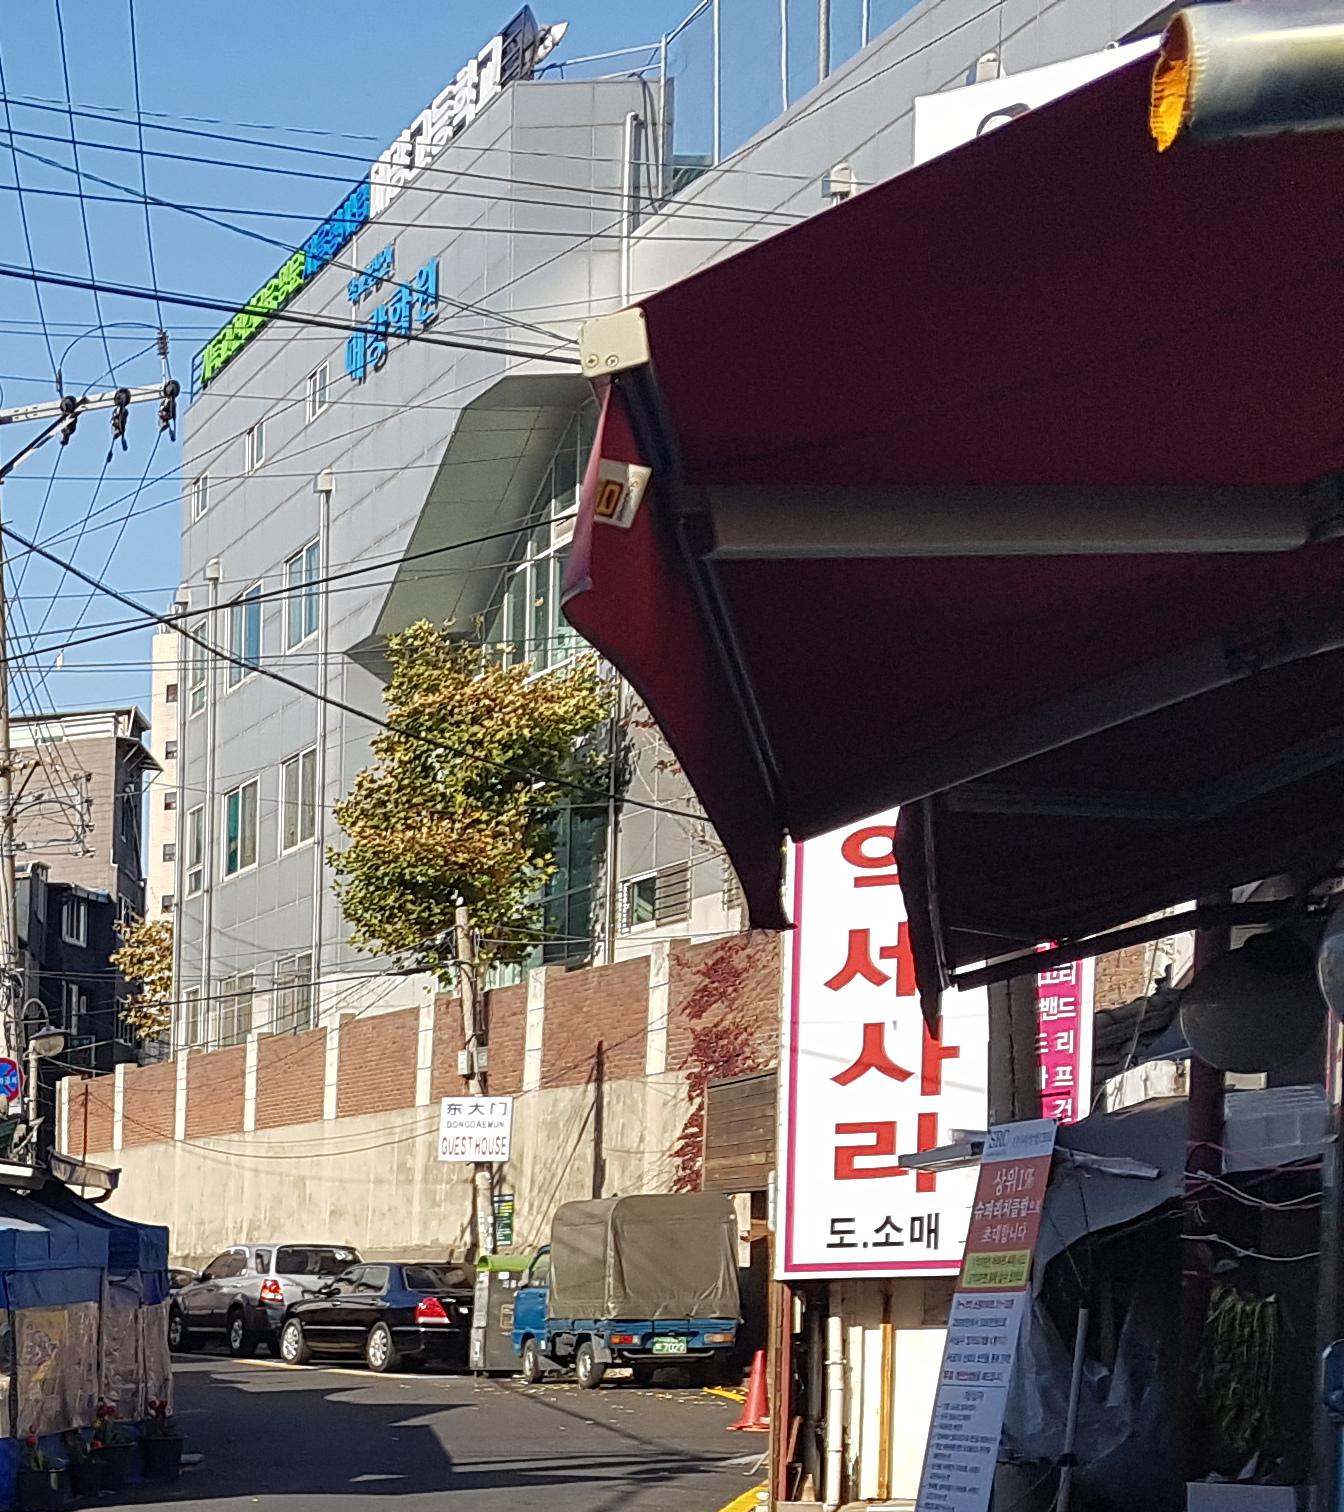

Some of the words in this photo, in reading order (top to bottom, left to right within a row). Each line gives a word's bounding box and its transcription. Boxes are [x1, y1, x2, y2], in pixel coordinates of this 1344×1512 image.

[446, 1102, 508, 1115] 东大门
[446, 1120, 505, 1129] DONGDAEMUN
[441, 1136, 473, 1156] GUEST
[475, 1136, 507, 1156] HOUSE
[826, 1212, 941, 1251] 도.소매
